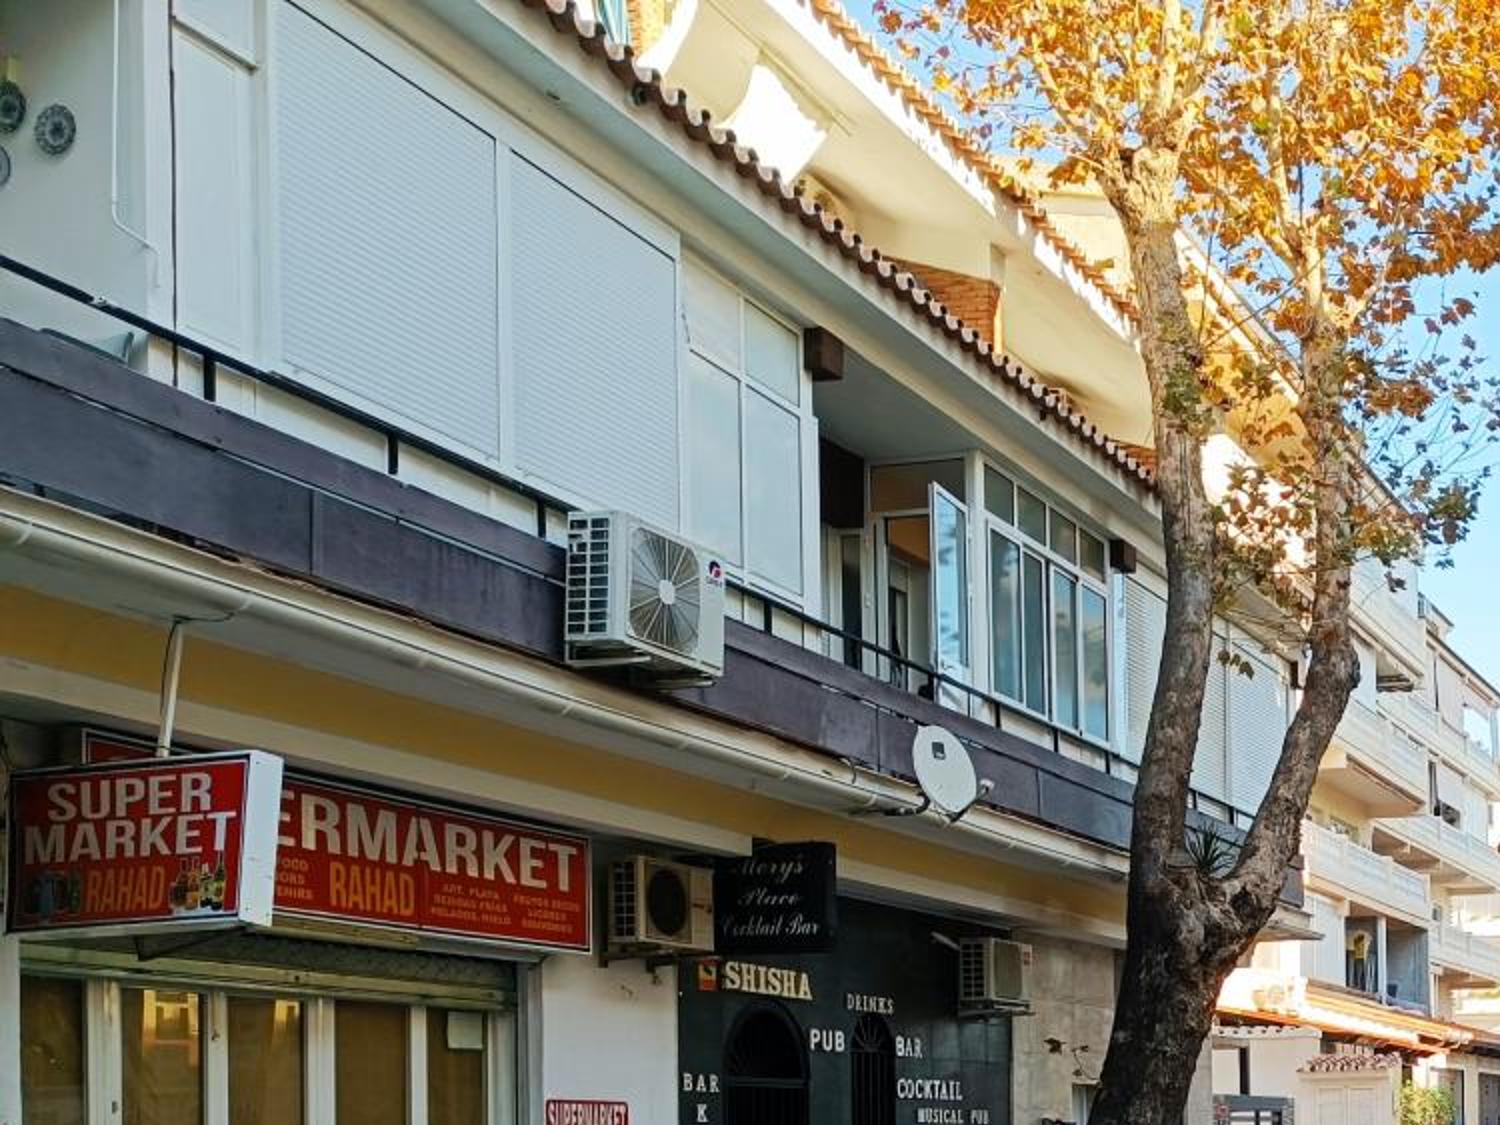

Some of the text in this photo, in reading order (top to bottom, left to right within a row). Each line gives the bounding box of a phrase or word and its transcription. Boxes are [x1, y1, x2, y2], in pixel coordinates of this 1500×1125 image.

[48, 771, 213, 822] SUPER
[24, 811, 237, 865] MARKET
[85, 865, 165, 914] RAHAD
[328, 861, 415, 917] RAHAD
[723, 961, 813, 1001] SHISHA
[846, 993, 894, 1015] DRINKS
[809, 1028, 846, 1052] PUB
[895, 1035, 923, 1058] BAR
[682, 1072, 720, 1094] BAR
[897, 1077, 964, 1101] COCKTAIL
[917, 1107, 990, 1125] MUSICAL PUB
